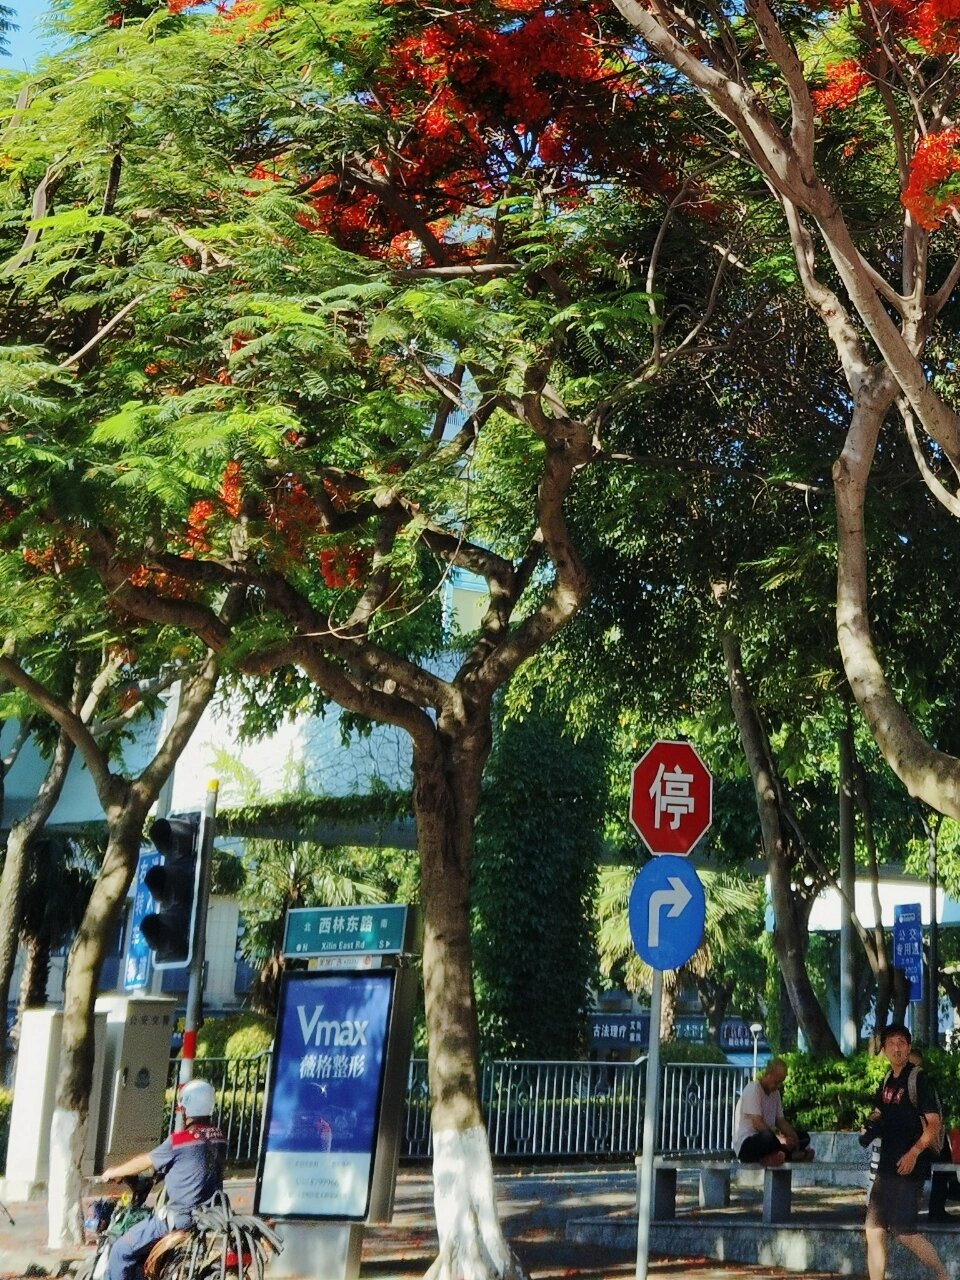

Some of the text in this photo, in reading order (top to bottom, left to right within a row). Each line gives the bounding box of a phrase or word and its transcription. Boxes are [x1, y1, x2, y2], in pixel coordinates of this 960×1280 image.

[649, 762, 695, 830] 停
[304, 915, 388, 934] 北 西林东路 南
[898, 928, 917, 941] 公交
[302, 940, 385, 952] N Xilin East Rd S
[297, 1005, 369, 1047] Vmax
[593, 1023, 627, 1038] 古法理疗
[300, 1054, 366, 1079] 薇格整形
